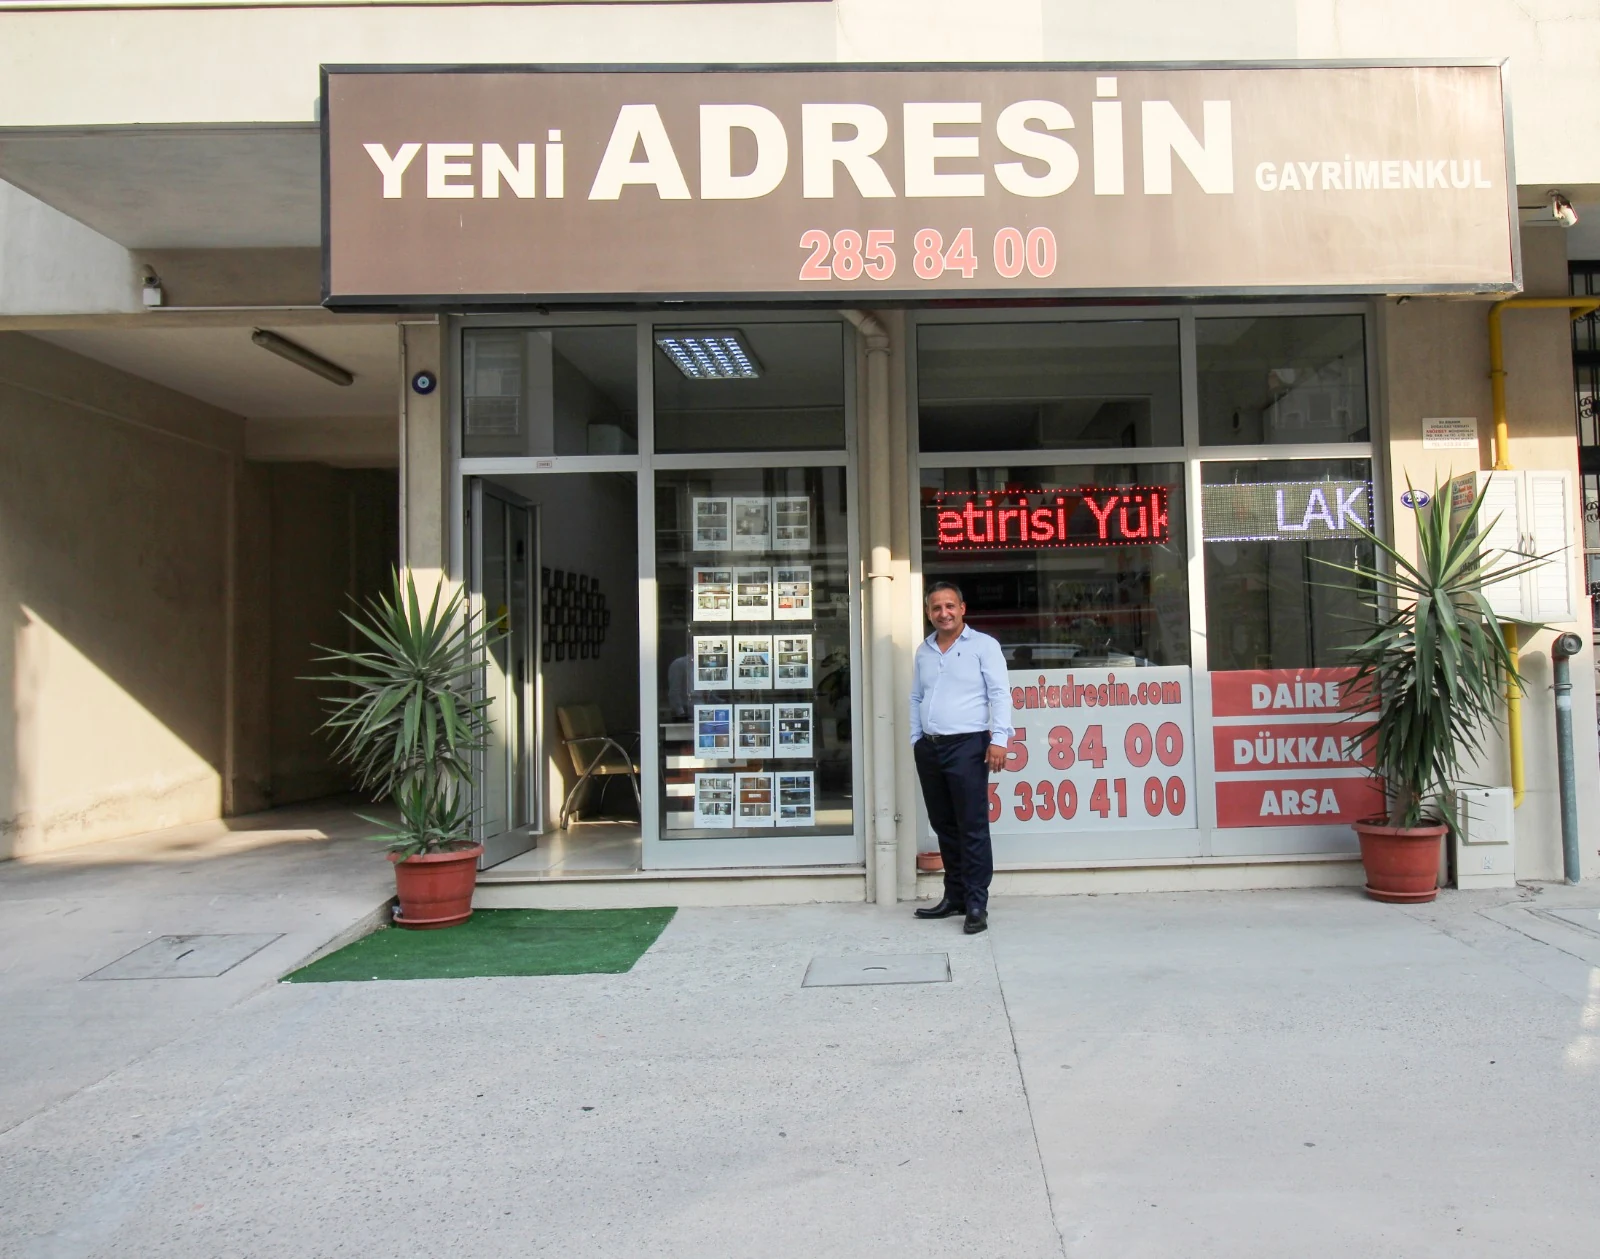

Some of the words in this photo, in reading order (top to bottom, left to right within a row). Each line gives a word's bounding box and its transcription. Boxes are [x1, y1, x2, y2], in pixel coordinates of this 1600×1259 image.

[363, 129, 564, 199] YENİ
[587, 76, 1235, 201] ADRESİN
[1255, 152, 1491, 192] GAYRİMENKUL
[799, 228, 897, 282] 285
[913, 227, 978, 281] 84
[993, 226, 1058, 279] 00
[938, 498, 1067, 544] etirisi
[1083, 493, 1168, 540] Yük
[1276, 486, 1367, 532] LAK
[1010, 672, 1182, 711] eniadresin.com
[1252, 676, 1340, 711] DAİRE
[1047, 724, 1107, 771] 84
[1124, 721, 1185, 768] 00
[1233, 731, 1363, 766] DÜKKAN
[1013, 779, 1078, 822] 330
[1089, 777, 1128, 819] 41
[1143, 775, 1187, 818] 00
[1259, 787, 1341, 817] ARSA
